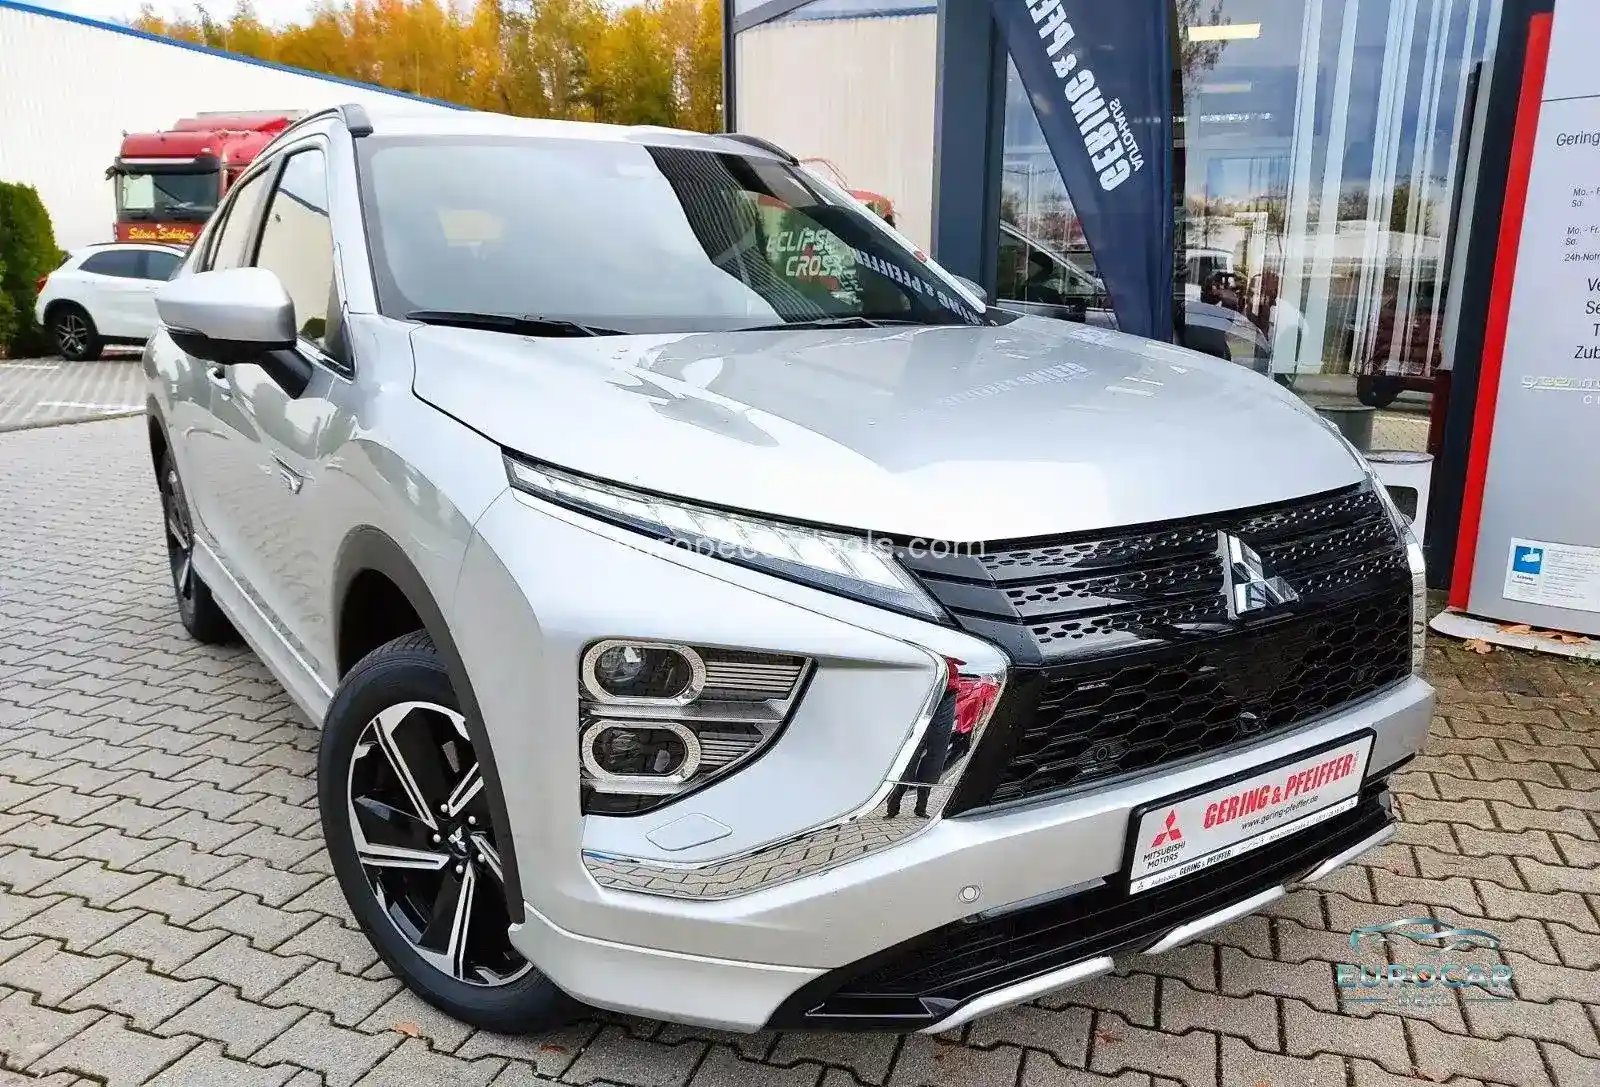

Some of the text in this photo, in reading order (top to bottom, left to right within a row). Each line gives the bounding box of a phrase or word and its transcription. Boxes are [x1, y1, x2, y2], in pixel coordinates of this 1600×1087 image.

[1556, 130, 1600, 146] Gering
[1203, 785, 1270, 829] GERING
[1271, 786, 1281, 805] &
[1284, 753, 1354, 801] PFEIFFER
[1241, 795, 1319, 830] www.gering-pfeiffer.de
[1143, 841, 1186, 862] MITSUBISHI
[1147, 852, 1179, 869] MOTORS
[1179, 862, 1202, 876] GERING
[1207, 849, 1232, 865] PFEIFFER
